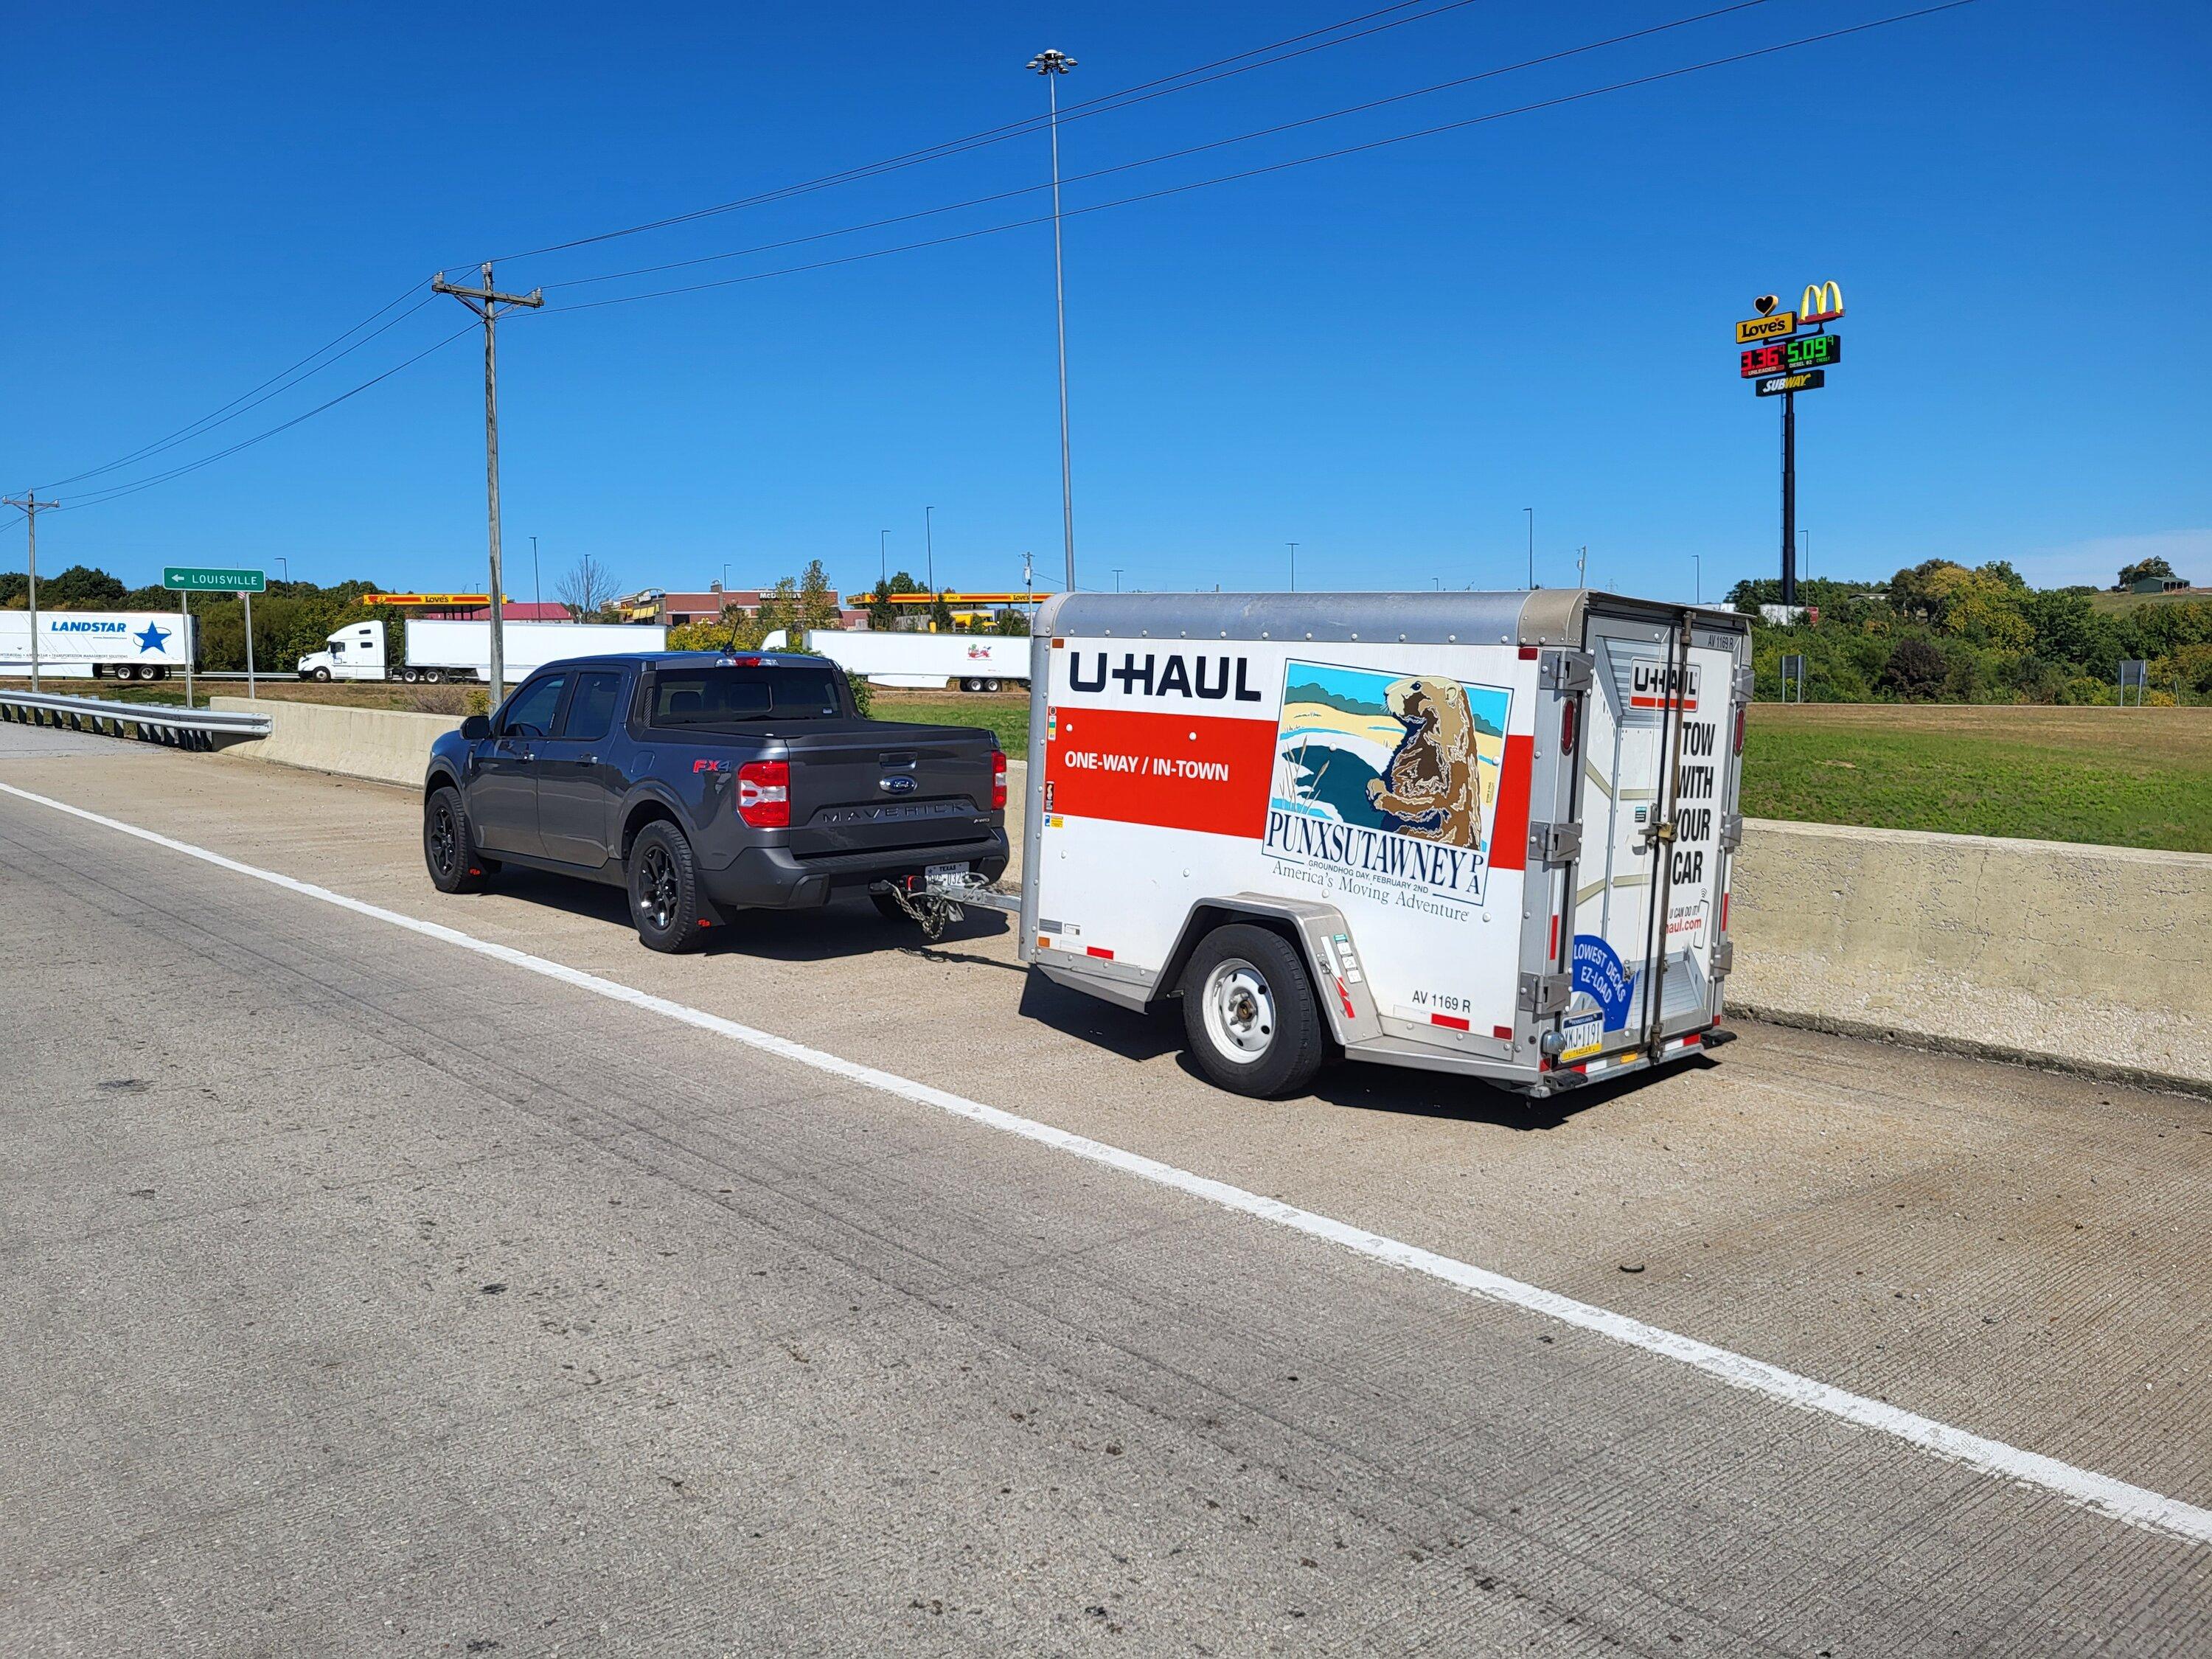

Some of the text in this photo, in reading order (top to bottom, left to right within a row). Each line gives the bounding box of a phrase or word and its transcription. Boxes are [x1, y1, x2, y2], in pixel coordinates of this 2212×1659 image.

[1741, 319, 1785, 338] Love's
[1747, 366, 1776, 375] UNLEADED
[1762, 372, 1812, 393] SUBWAY
[192, 574, 258, 585] LOUISVILLE
[51, 621, 127, 633] LANDSTAR
[1708, 634, 1733, 650] AV 1169 R
[1069, 651, 1262, 702] U-HAUL
[1635, 667, 1696, 695] U-HAUL
[1683, 721, 1716, 757] TOW
[693, 759, 731, 773] FX4
[1065, 751, 1139, 773] ONE-WAY
[1152, 758, 1228, 782] IN-TOWN
[1677, 765, 1714, 799] WITH
[822, 802, 965, 823] MAVERICK
[1266, 811, 1467, 889] PUNXSUTAWNEY
[1308, 860, 1429, 894] GROUNDHOG DAY, FEBRUARY 2ND
[1672, 851, 1703, 886] CAR
[1273, 860, 1468, 922] America's Moving Adventure
[1669, 908, 1674, 919] U
[1674, 907, 1684, 918] CAN
[1685, 905, 1692, 917] DO
[1573, 944, 1626, 1003] LOWEST DECKS
[1581, 966, 1613, 1004] EZ-LOAD
[1412, 990, 1471, 1013] AV 1169 R
